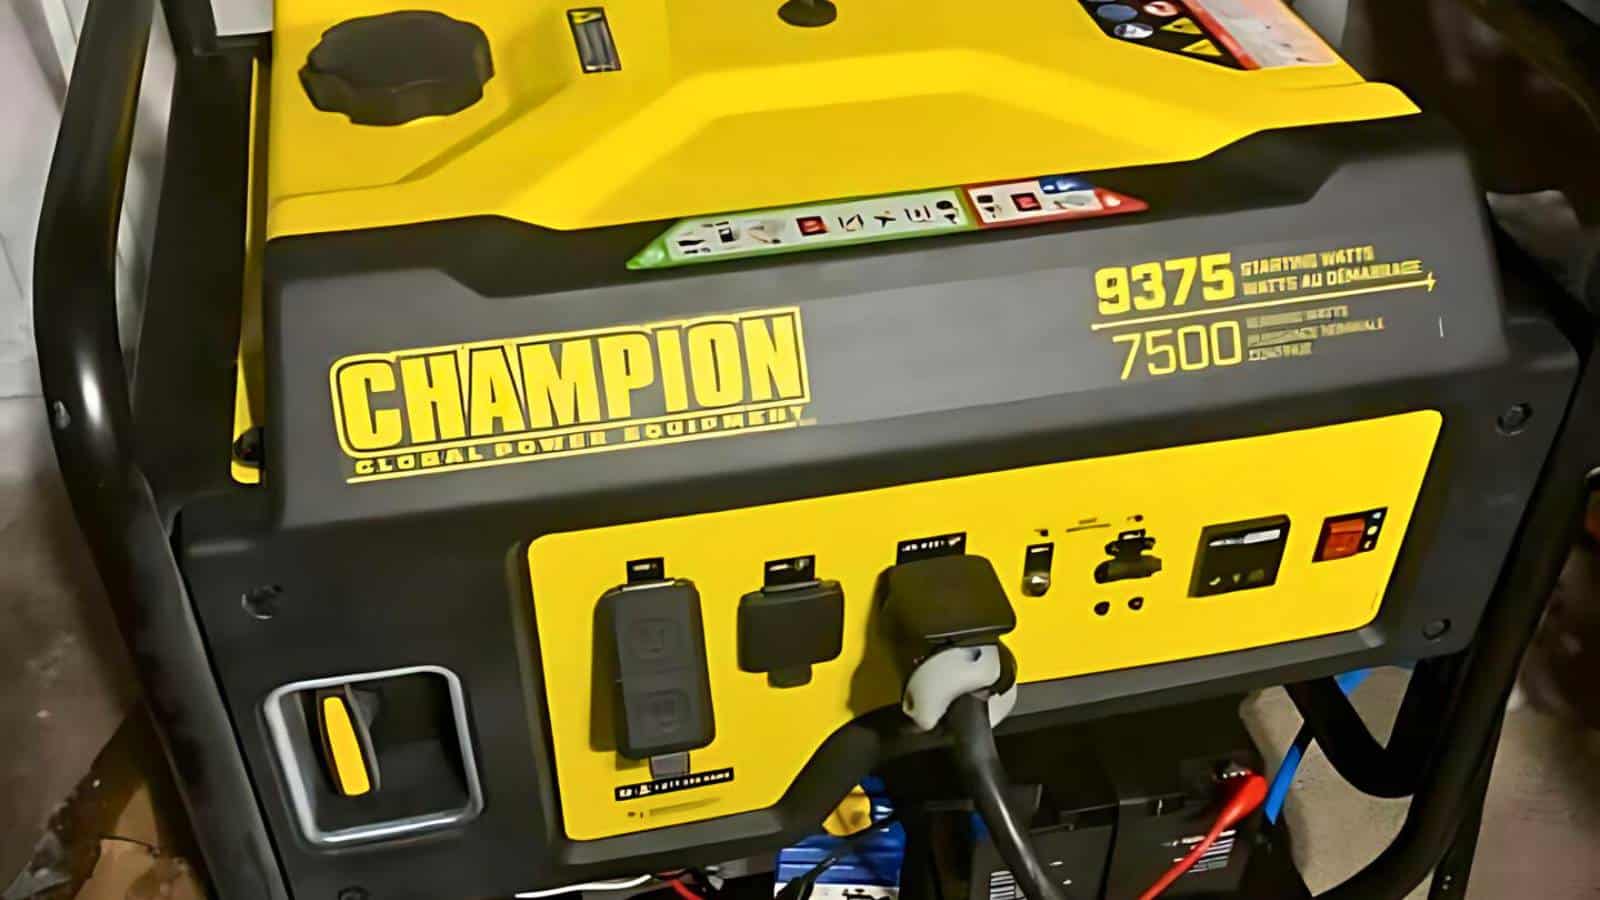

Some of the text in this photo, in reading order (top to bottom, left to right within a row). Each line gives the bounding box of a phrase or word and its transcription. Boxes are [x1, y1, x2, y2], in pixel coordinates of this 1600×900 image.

[1094, 252, 1237, 316] 9375
[1302, 271, 1322, 289] AU
[1111, 320, 1243, 381] 7500
[338, 312, 803, 452] CHAMPION
[354, 446, 483, 475] GLOBAL
[494, 430, 606, 458] POWER
